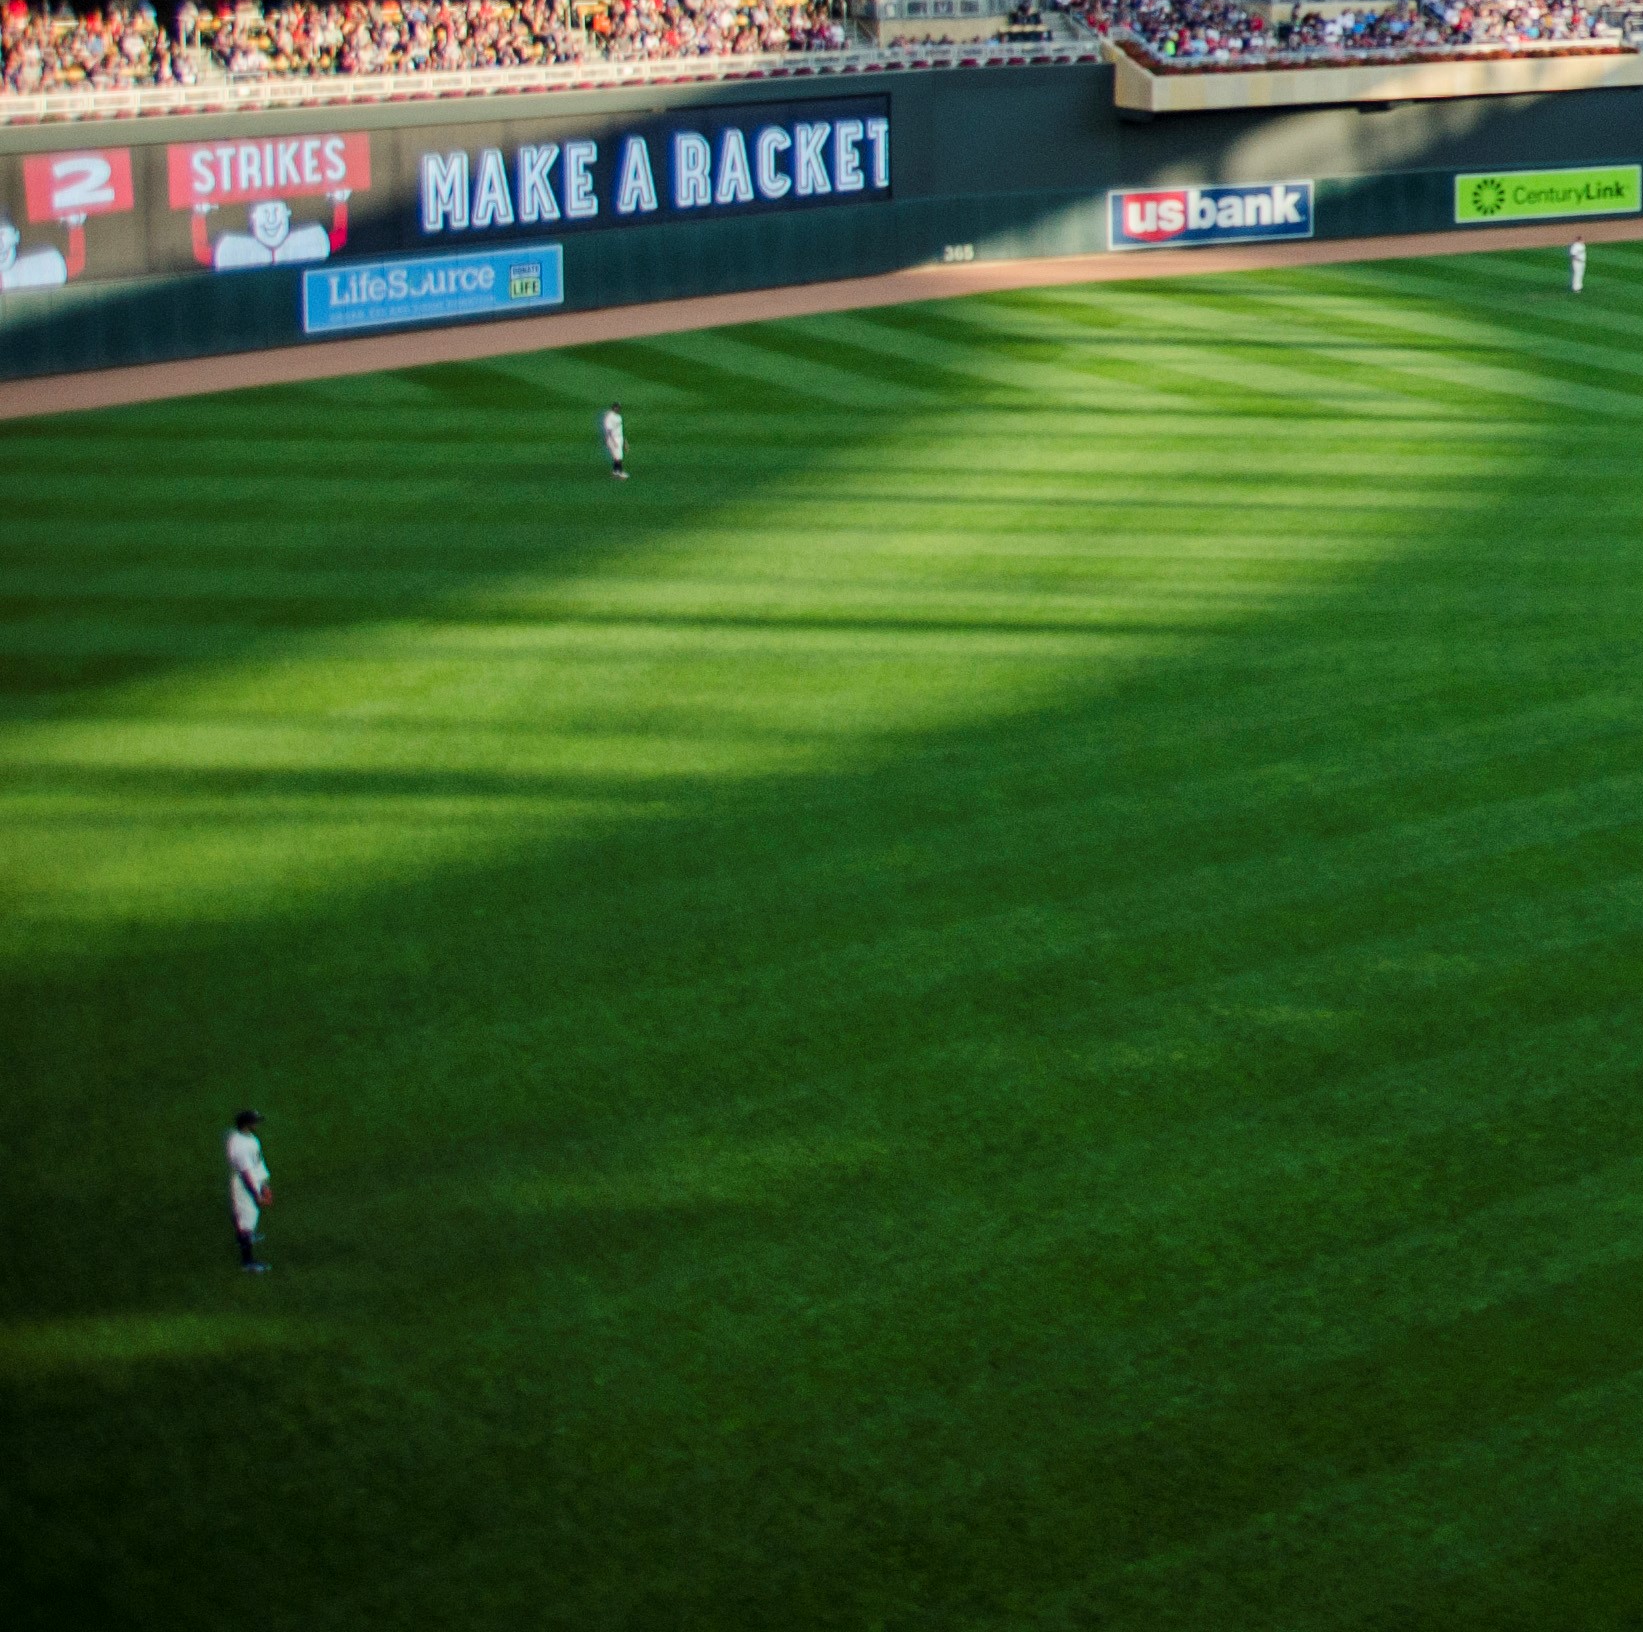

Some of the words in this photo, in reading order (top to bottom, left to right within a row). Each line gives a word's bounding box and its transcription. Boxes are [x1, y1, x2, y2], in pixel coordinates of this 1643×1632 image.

[51, 156, 116, 210] 2
[190, 137, 347, 195] STRIKES
[420, 140, 598, 233] MAKE
[617, 135, 659, 214] A
[672, 116, 890, 210] RACKET
[1512, 180, 1627, 206] CenturyLink
[512, 278, 541, 297] LIFE
